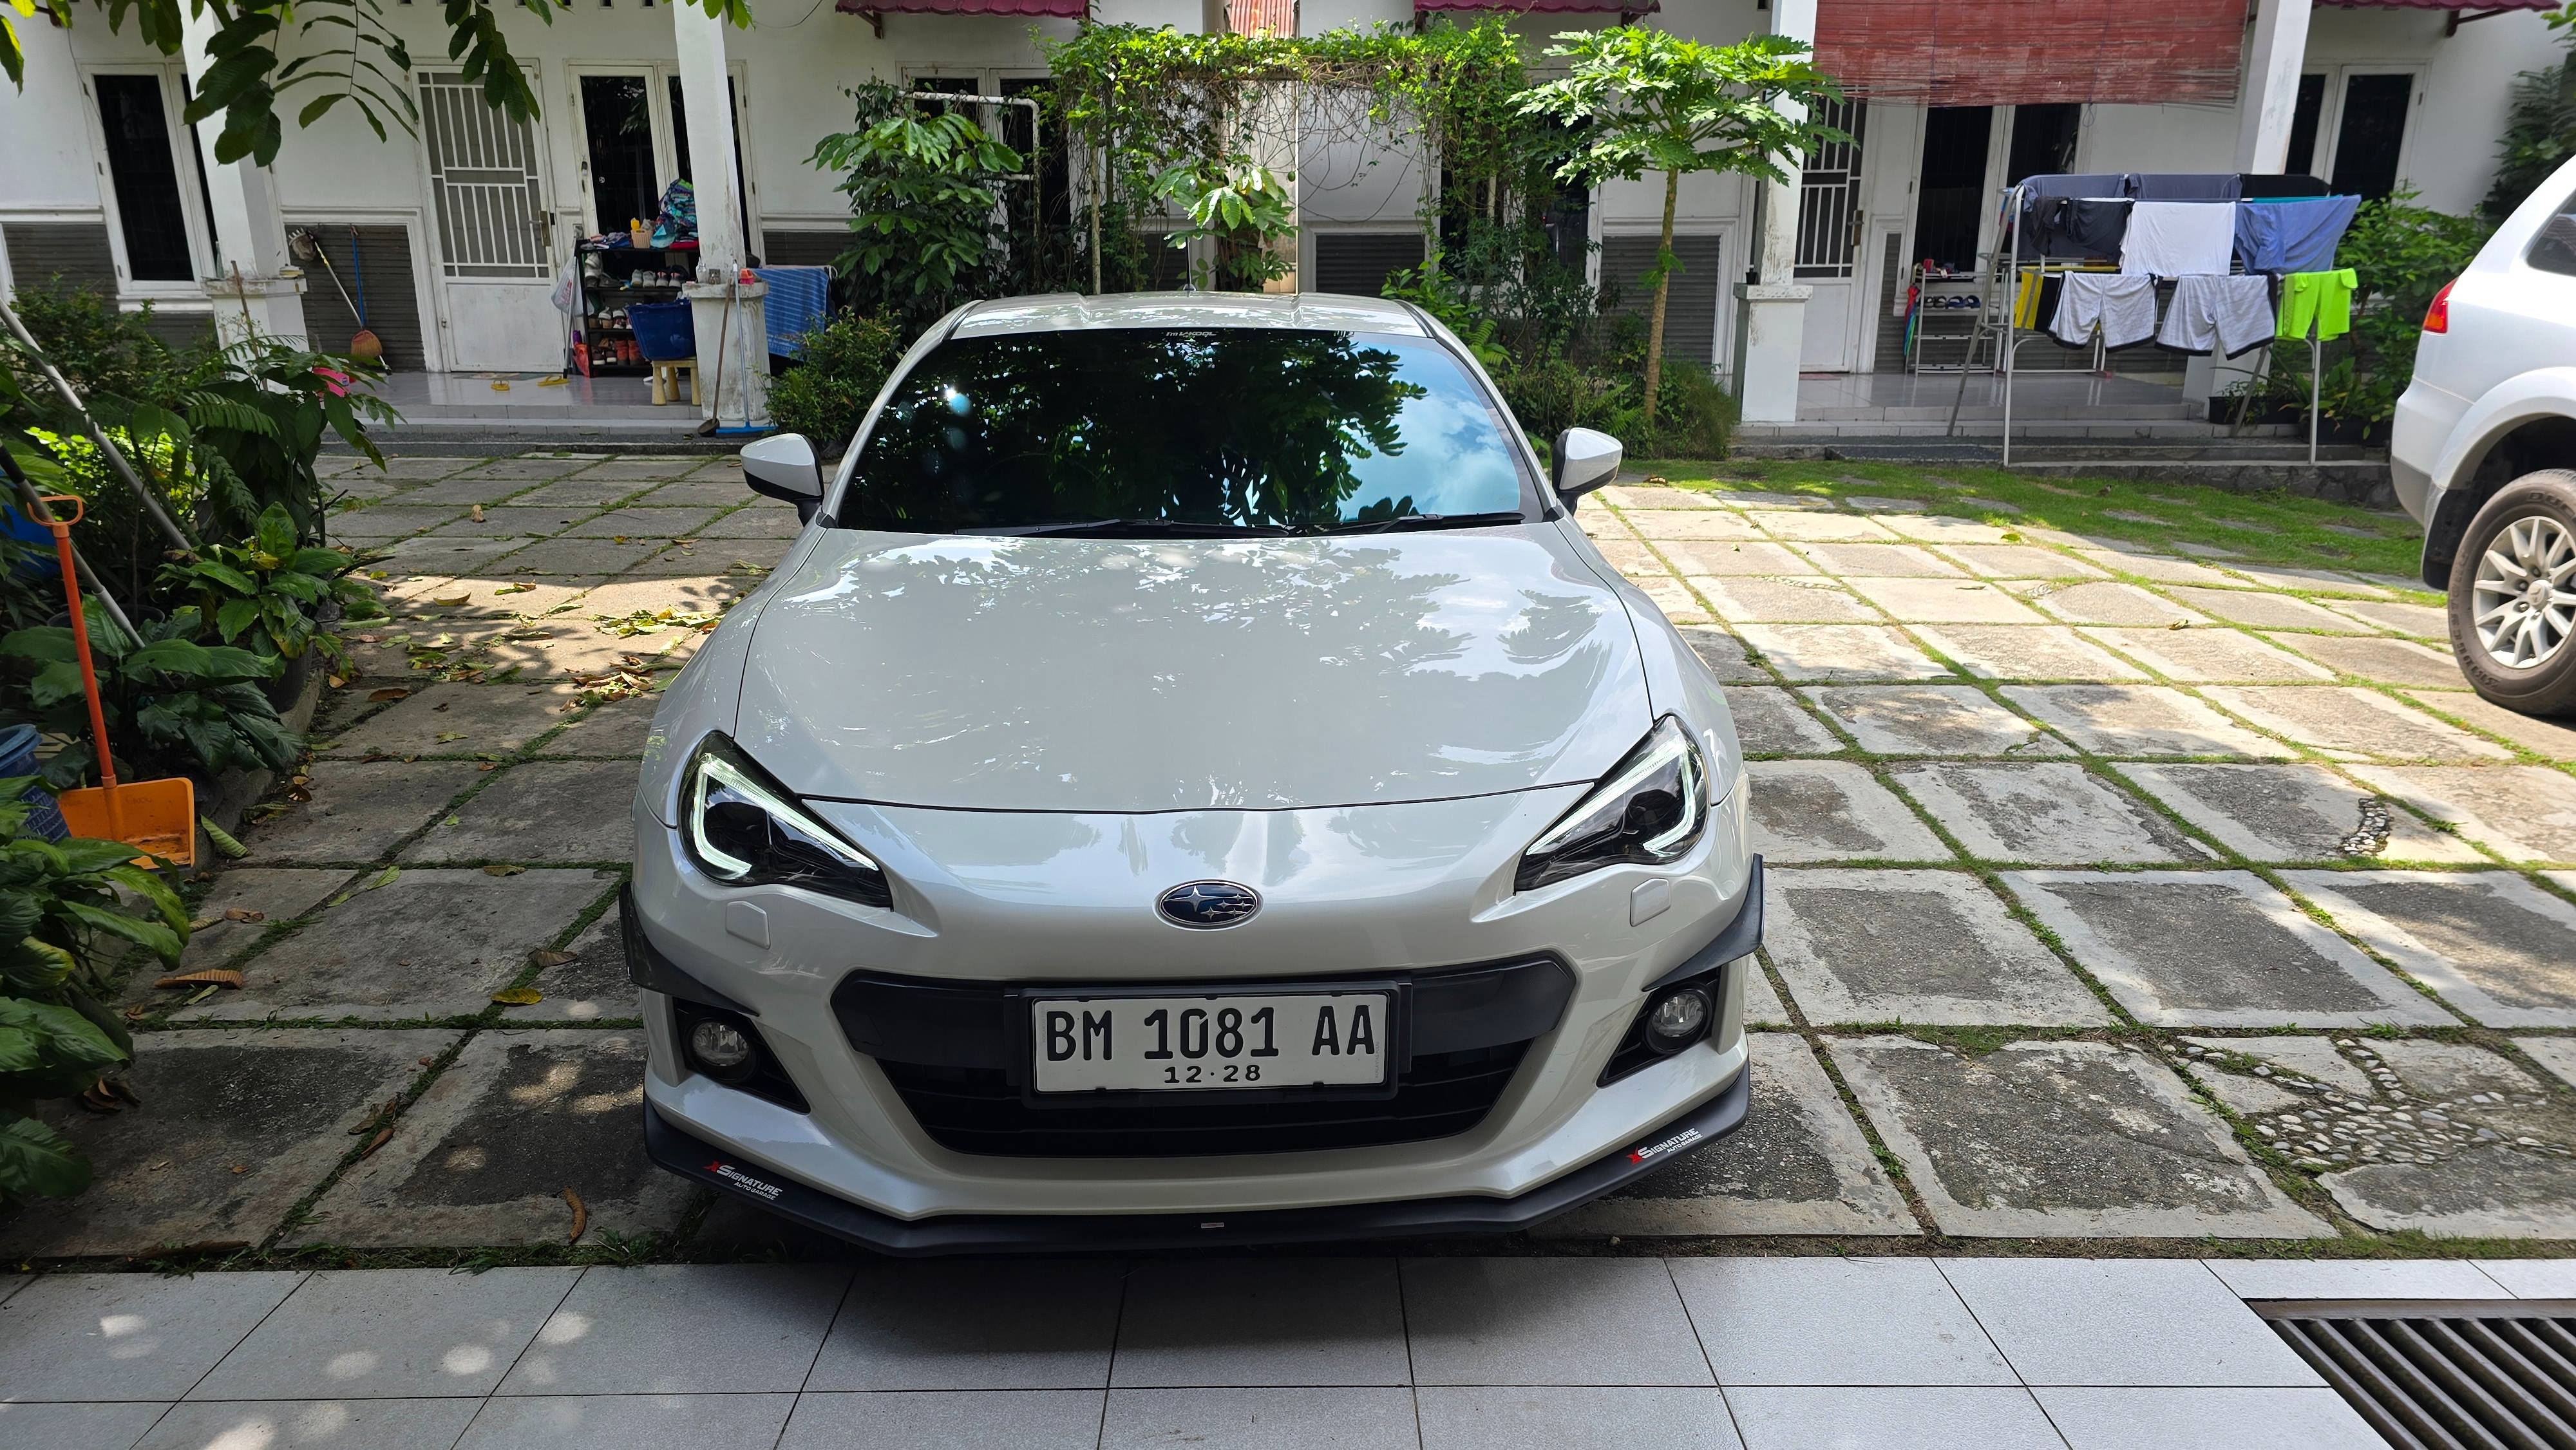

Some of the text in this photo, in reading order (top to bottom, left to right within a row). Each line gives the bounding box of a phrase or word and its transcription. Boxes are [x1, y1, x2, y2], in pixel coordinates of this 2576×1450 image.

[1046, 1010, 1112, 1061] BM
[1144, 1007, 1279, 1059] 1081
[1311, 1005, 1375, 1056] AA
